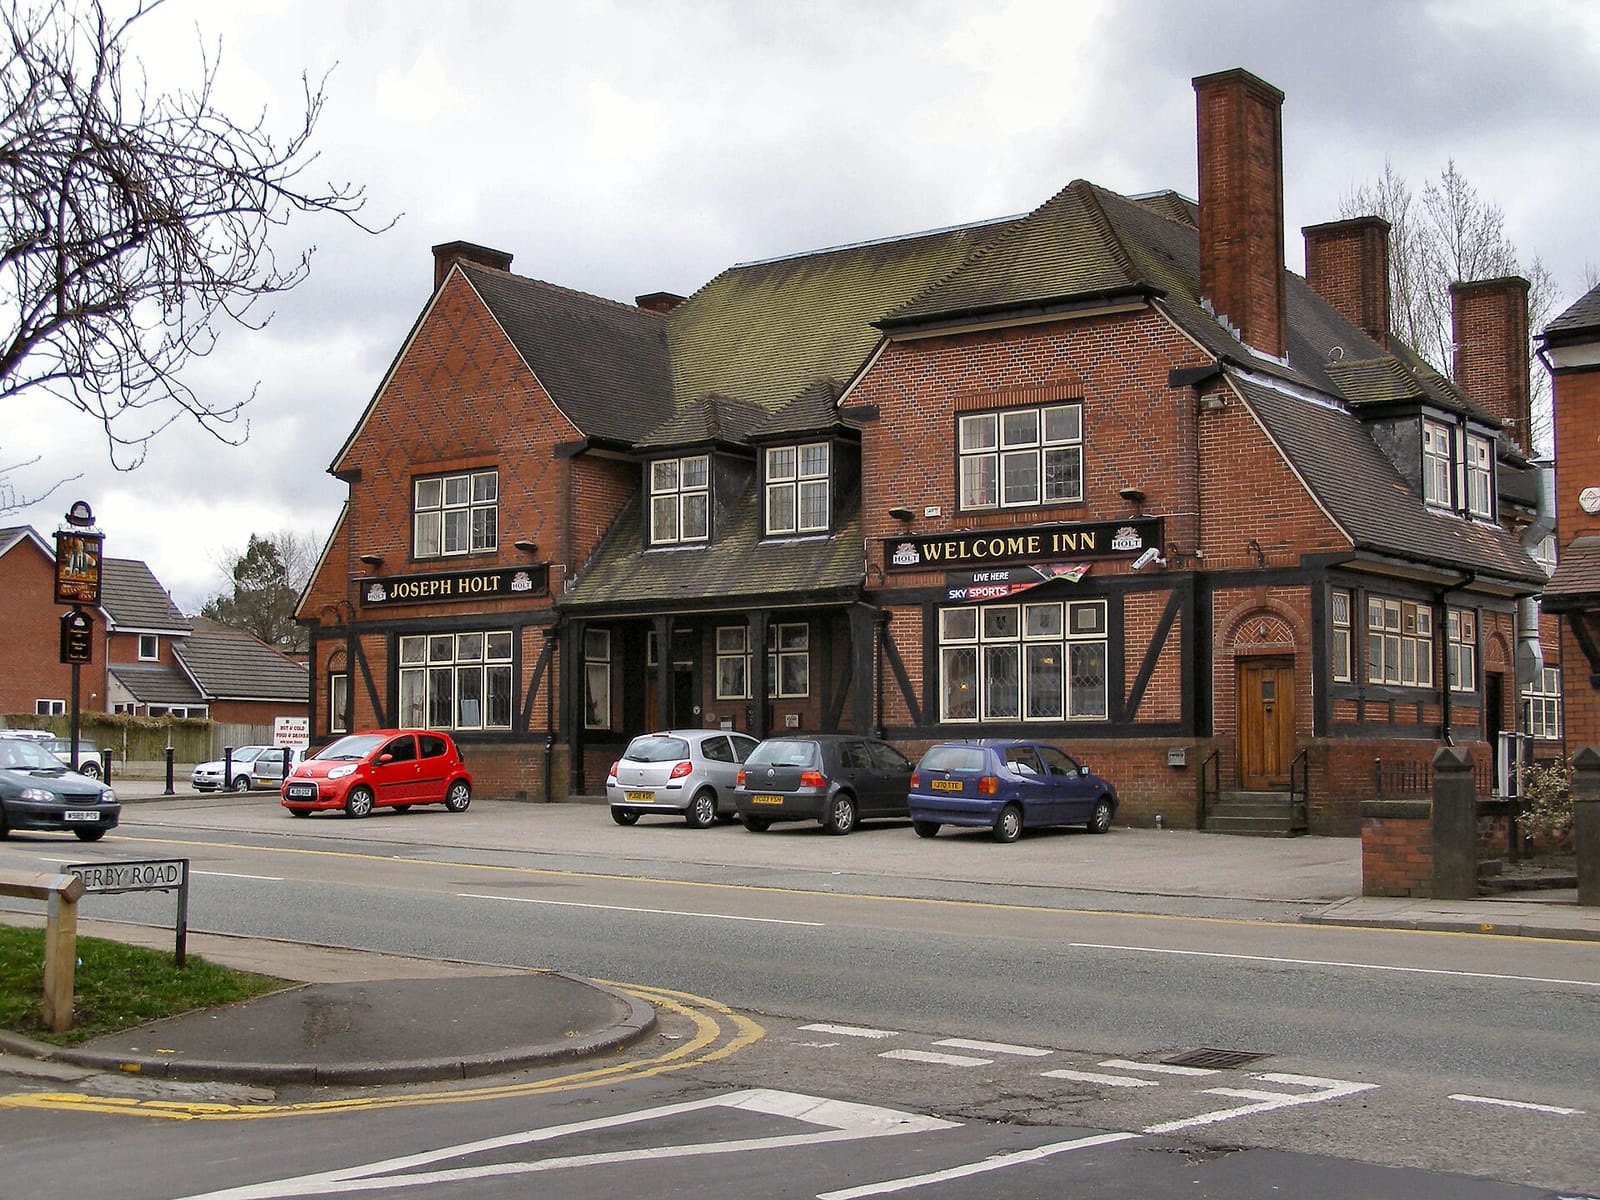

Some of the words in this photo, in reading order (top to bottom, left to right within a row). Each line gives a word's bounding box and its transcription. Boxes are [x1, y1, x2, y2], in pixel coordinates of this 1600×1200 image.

[923, 536, 1041, 561] WELCOME
[1052, 531, 1096, 552] INN
[1112, 540, 1141, 549] HOLT
[893, 554, 918, 563] HOLT
[973, 572, 989, 582] LIVE
[990, 571, 1009, 581] HERE
[390, 579, 451, 599] JOSEPH
[458, 575, 501, 593] HOLT
[512, 581, 532, 590] HOLT
[949, 588, 968, 599] SKY
[969, 585, 1008, 598] SPORTS
[71, 867, 125, 887] DERBY
[132, 865, 178, 884] ROAD
